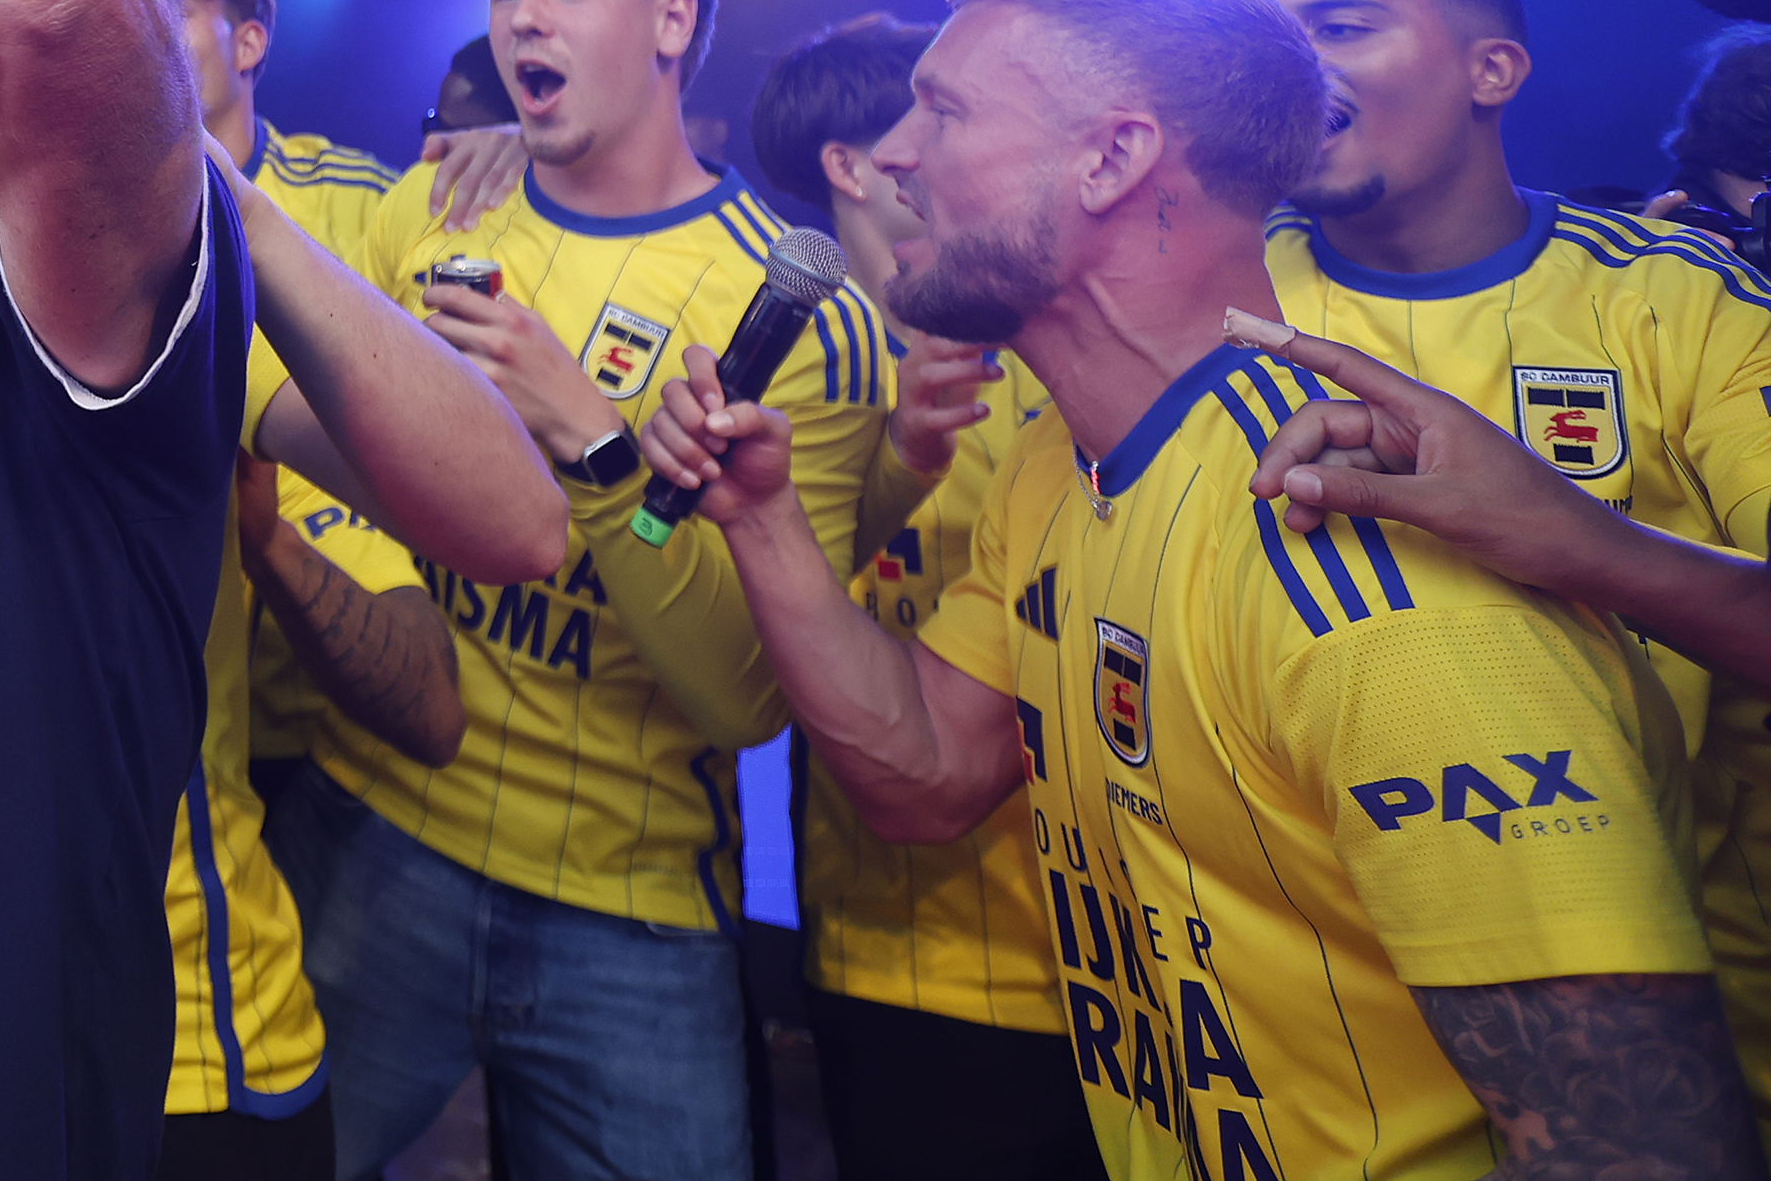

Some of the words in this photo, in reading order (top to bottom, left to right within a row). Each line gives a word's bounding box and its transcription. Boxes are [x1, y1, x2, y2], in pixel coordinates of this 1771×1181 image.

[1540, 373, 1610, 386] CAMBUUR
[1347, 749, 1600, 846] PAX
[1511, 814, 1610, 840] GROEP
